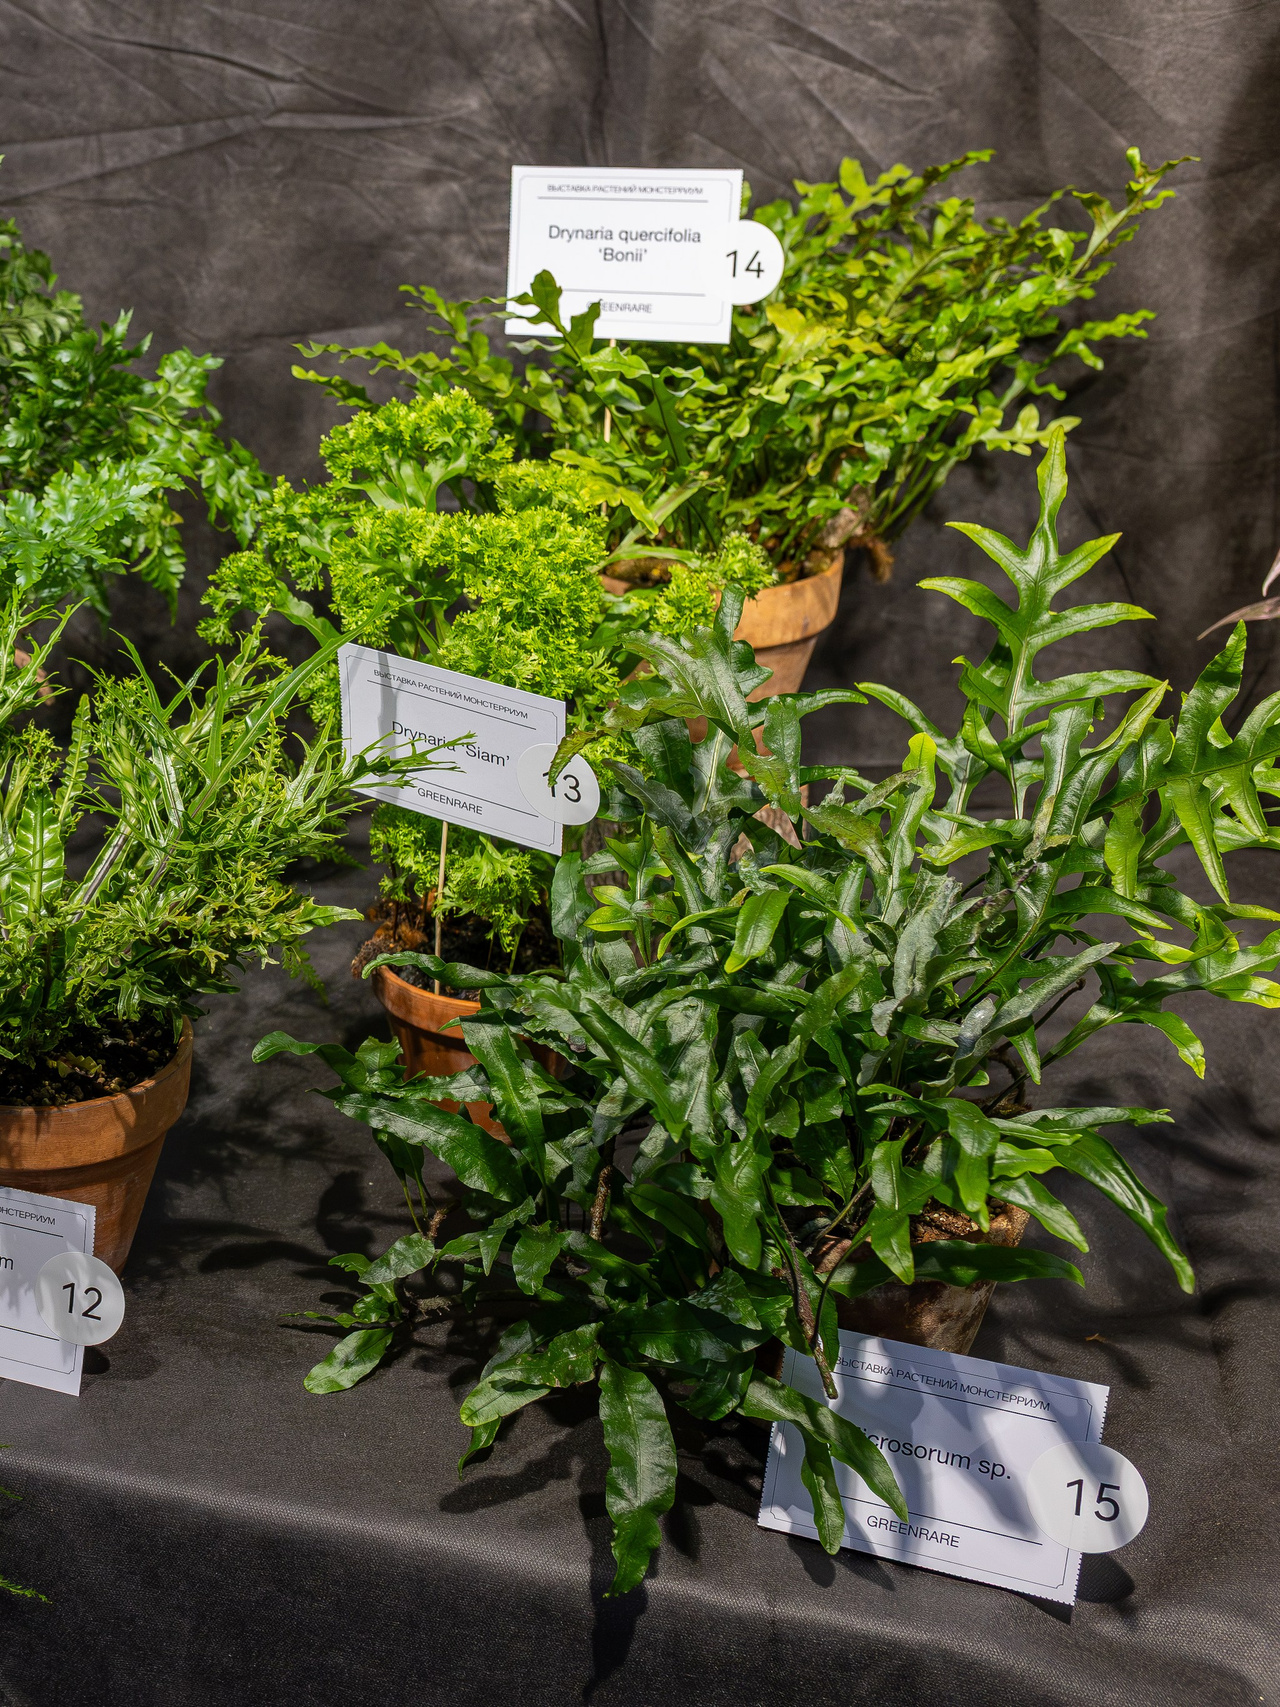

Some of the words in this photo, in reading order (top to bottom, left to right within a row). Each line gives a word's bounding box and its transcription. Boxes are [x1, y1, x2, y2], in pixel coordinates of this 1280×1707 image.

[548, 225, 614, 243] Drynaria
[618, 228, 702, 244] quercifolia
[726, 250, 765, 279] 14
[586, 301, 653, 314] EENRARE
[373, 669, 417, 687] ВЫСТАВКА
[417, 682, 463, 701] РАСТЕНИЙ
[463, 695, 529, 720] МОНСТЕРРИУМ
[417, 787, 483, 816] GREENRARE
[62, 1282, 103, 1321] 12
[895, 1369, 959, 1391] РАСТЕНИЙ
[960, 1383, 1051, 1412] МОНСТЕРРИУМ
[977, 1459, 1012, 1480] sp.
[1066, 1478, 1121, 1522] 15
[866, 1515, 961, 1549] GREENRARE
